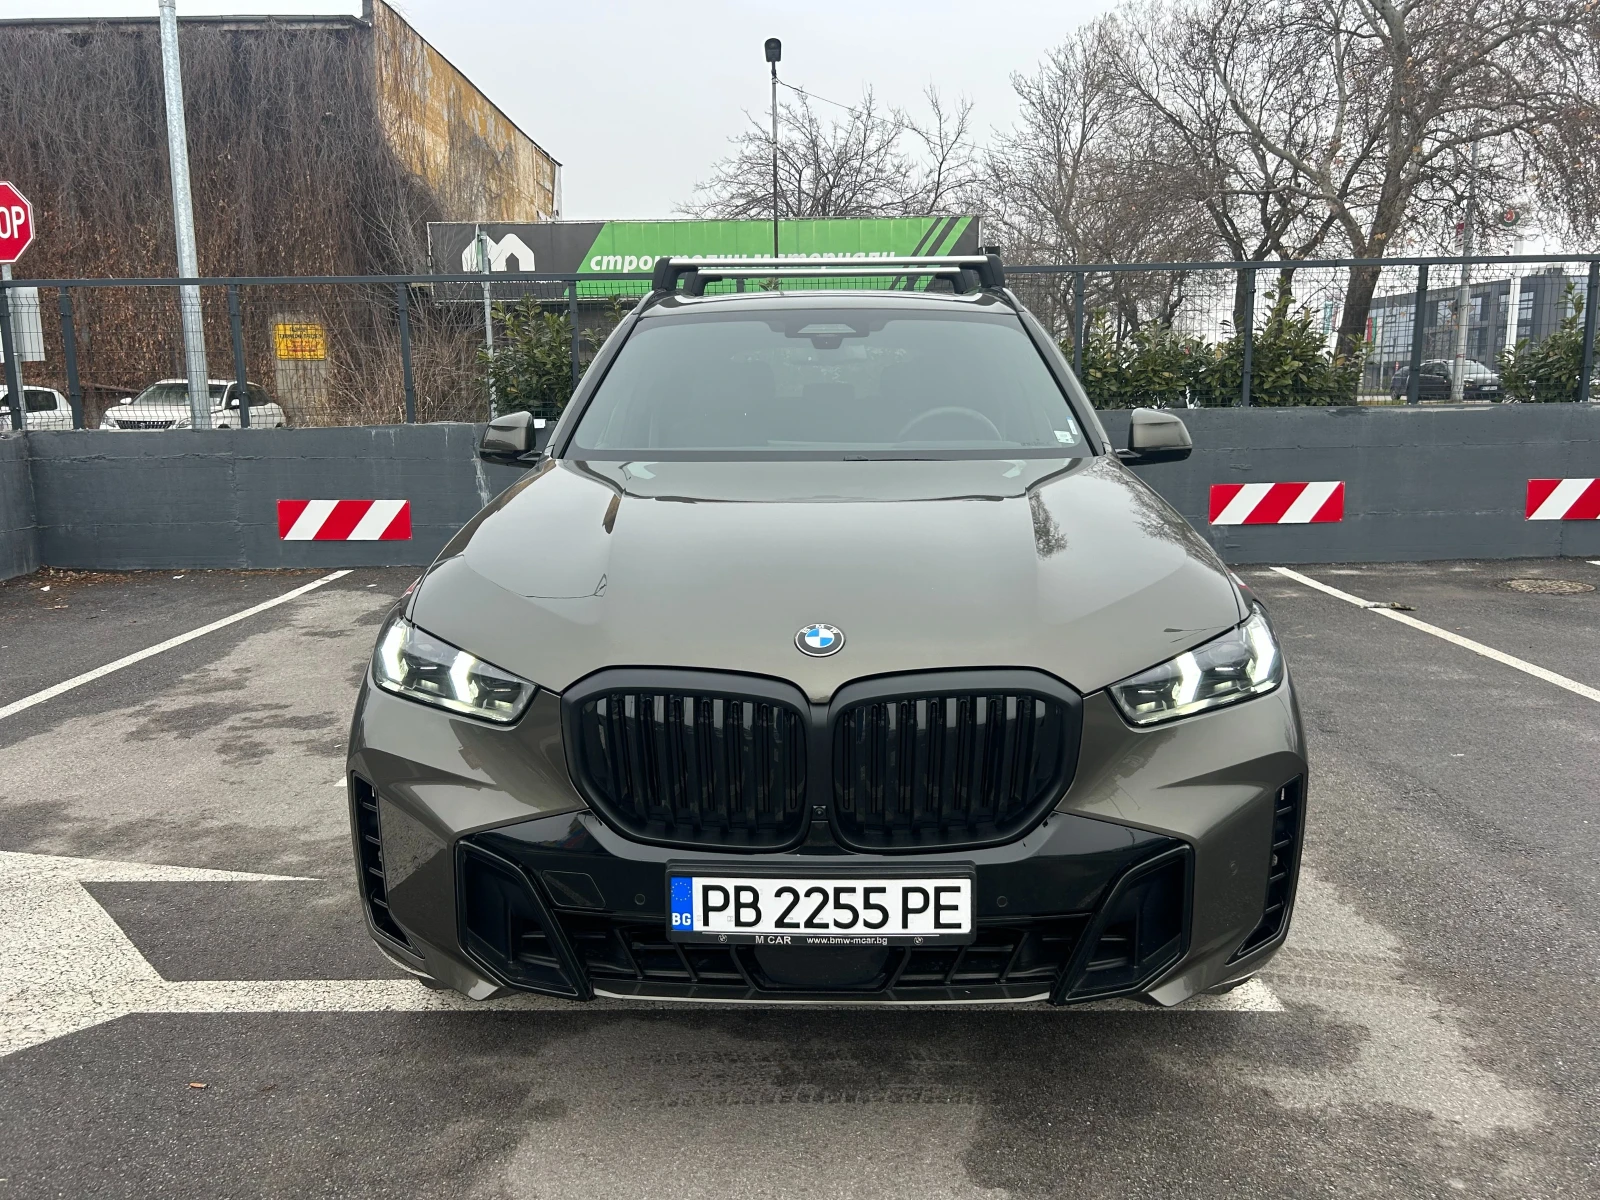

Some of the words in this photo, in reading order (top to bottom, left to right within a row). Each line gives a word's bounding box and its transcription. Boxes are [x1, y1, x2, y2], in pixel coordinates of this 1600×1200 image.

[702, 884, 762, 928] PB
[774, 886, 889, 929] 2255
[902, 886, 962, 930] PE
[672, 912, 692, 926] BG
[755, 935, 764, 944] M
[767, 935, 792, 945] CAR
[806, 936, 888, 946] www.bmw-mcar.bg
